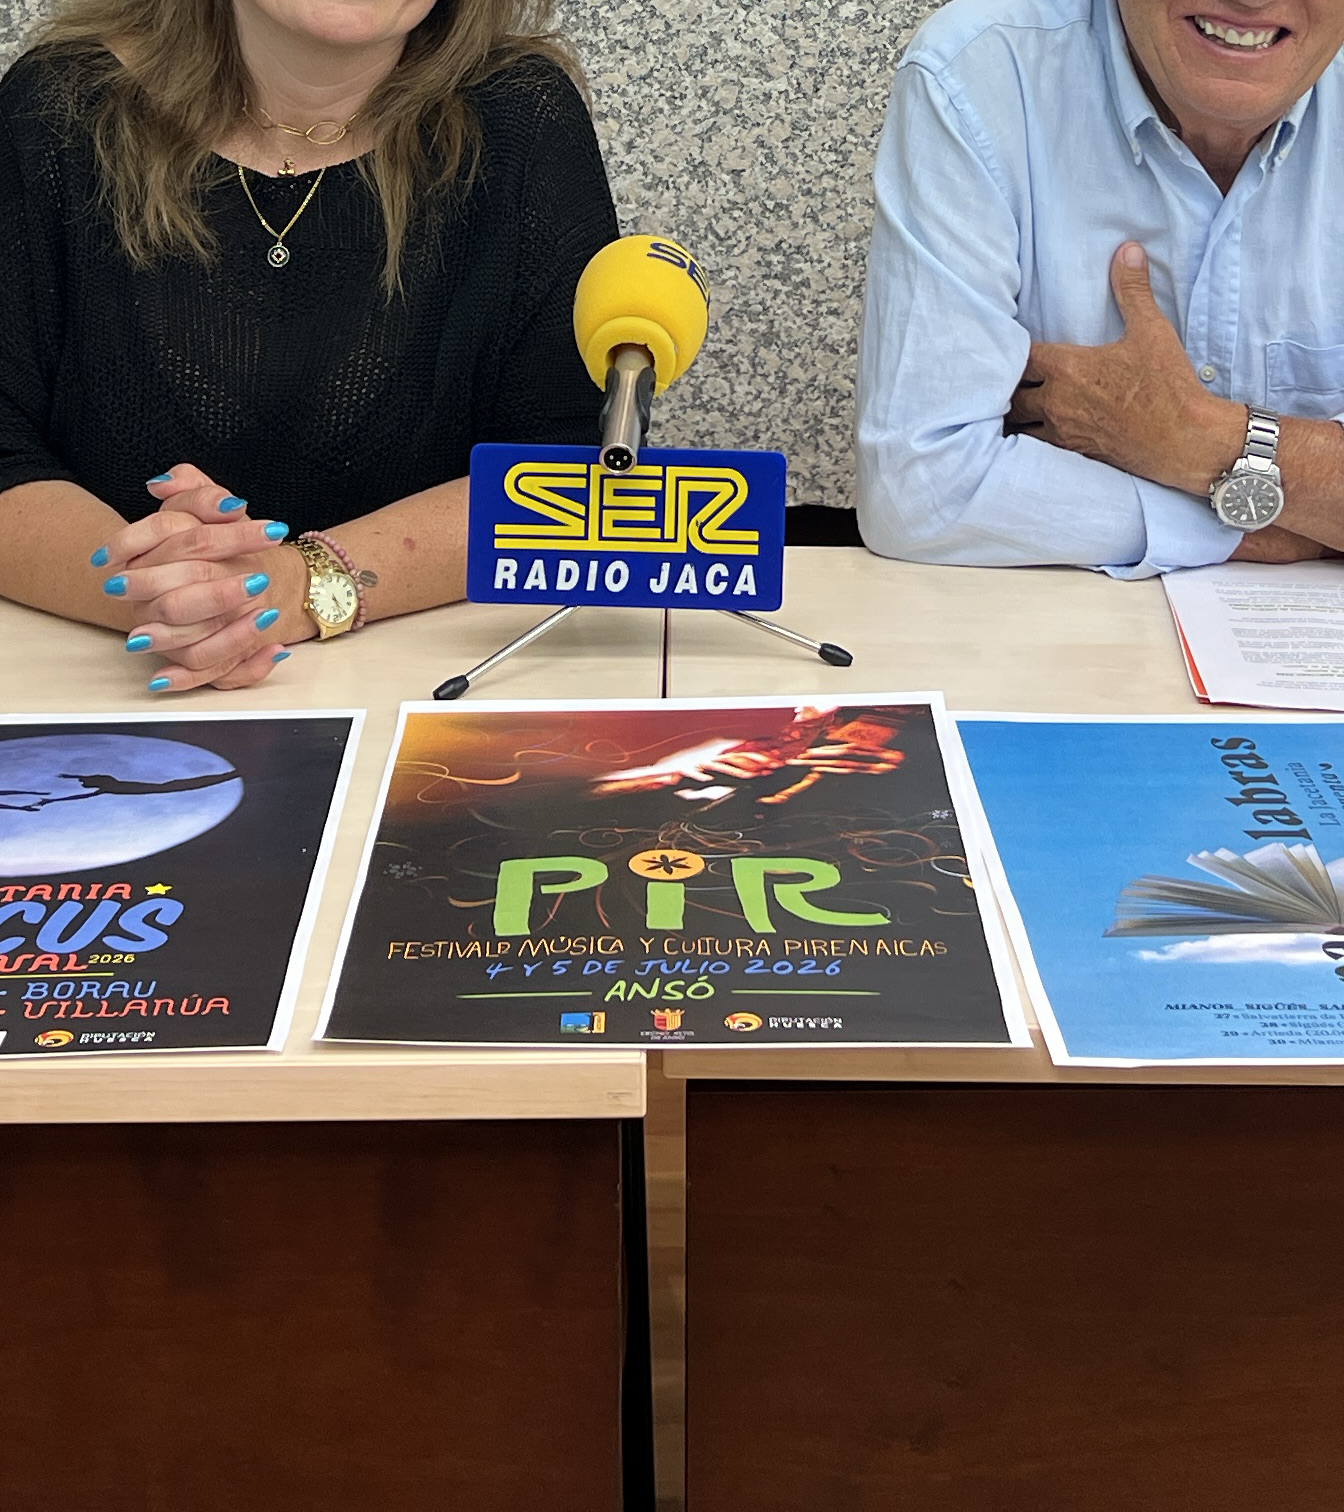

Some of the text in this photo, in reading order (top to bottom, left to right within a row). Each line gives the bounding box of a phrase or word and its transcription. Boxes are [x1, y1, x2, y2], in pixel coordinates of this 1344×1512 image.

[494, 462, 759, 555] SER
[494, 558, 757, 596] RADIO JACA
[1211, 737, 1314, 841] labras
[1319, 812, 1342, 826] La
[518, 935, 624, 958] MÚSICA
[639, 936, 655, 954] Y
[664, 936, 771, 958] CULTURA
[784, 938, 948, 958] PIRENAICAS
[88, 954, 135, 964] 2026
[486, 958, 842, 980] 4 Y 5 DE JULIO 2026
[21, 981, 157, 1000] BORAU
[604, 975, 715, 1002] ANSÓ
[23, 994, 230, 1020] VILLANÚA
